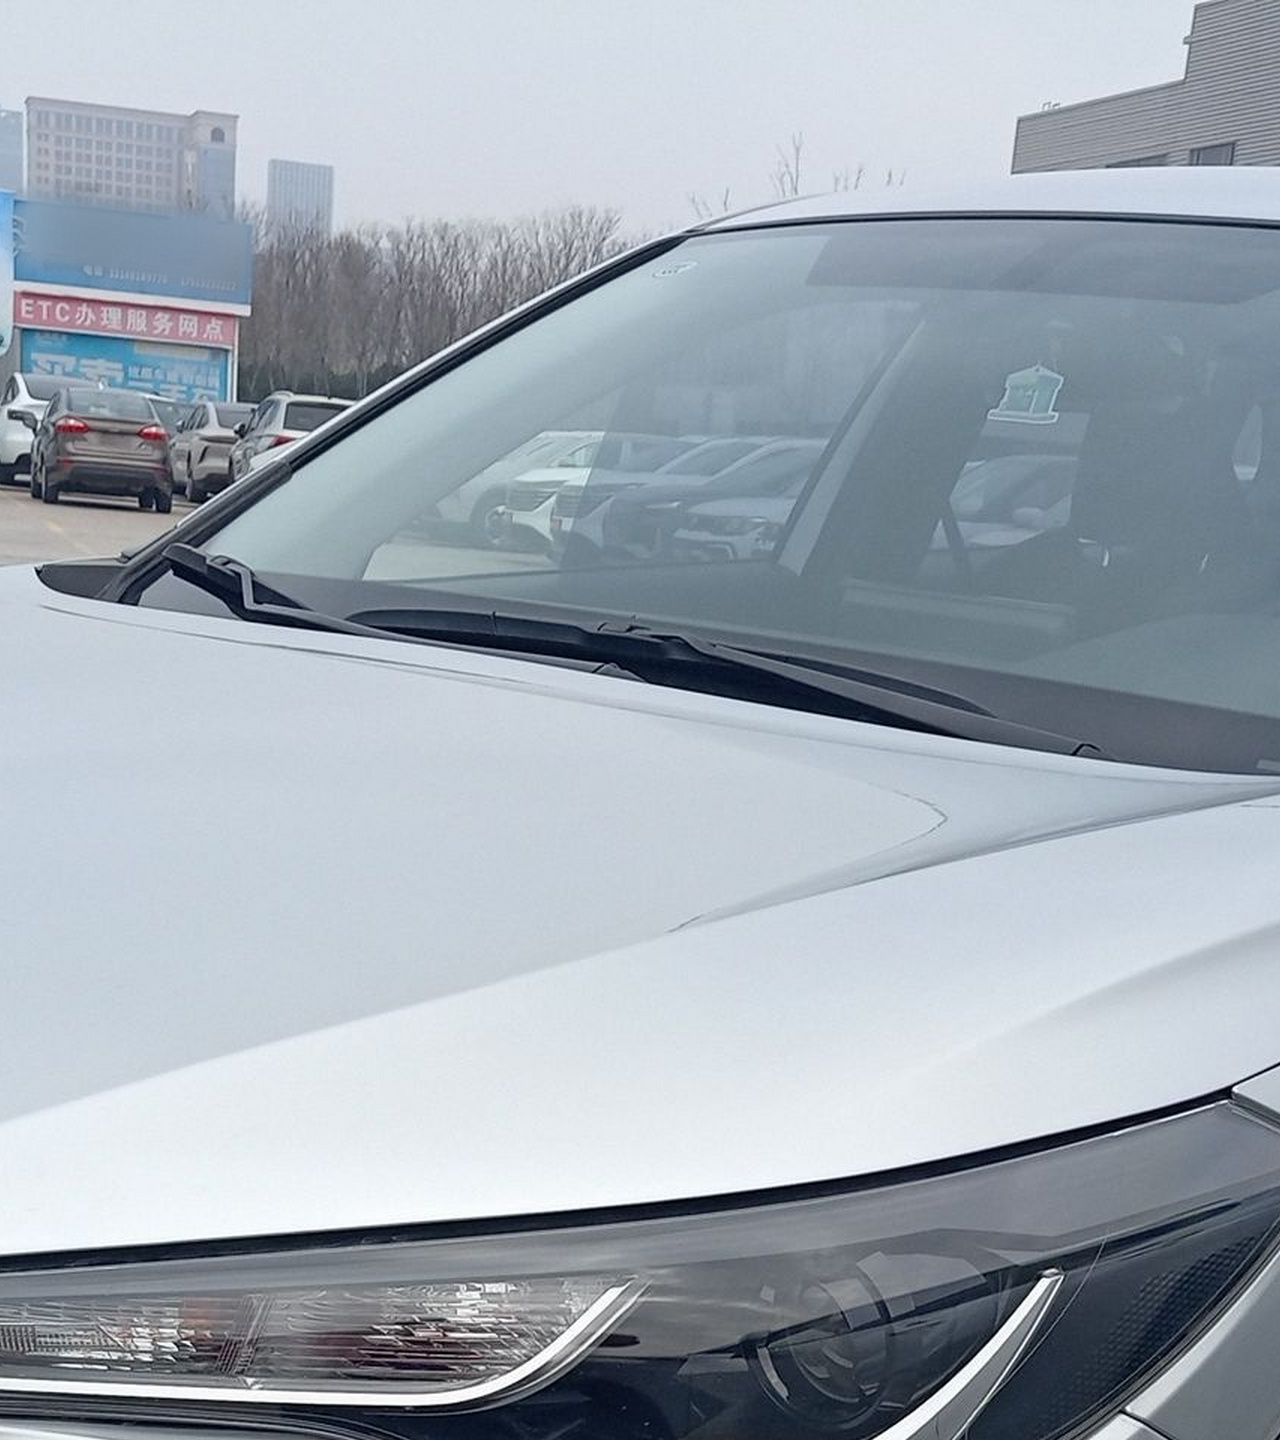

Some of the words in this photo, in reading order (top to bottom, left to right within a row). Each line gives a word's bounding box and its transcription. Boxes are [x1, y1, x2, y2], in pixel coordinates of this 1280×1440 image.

[21, 299, 224, 340] ETC办理服务网点
